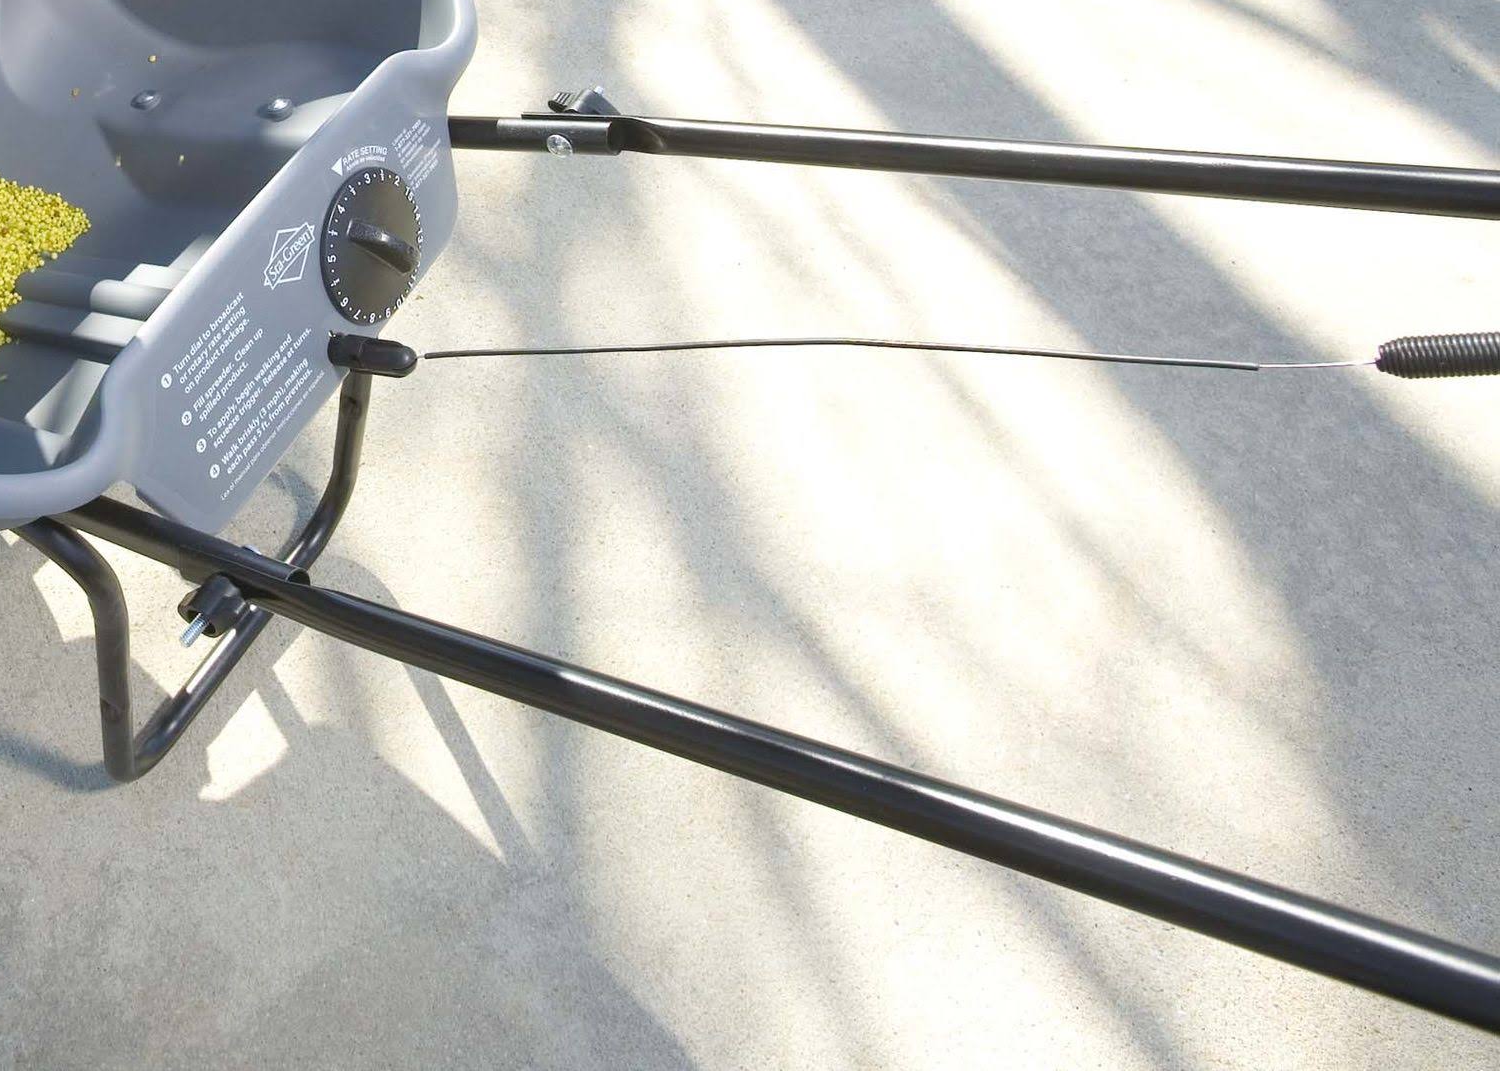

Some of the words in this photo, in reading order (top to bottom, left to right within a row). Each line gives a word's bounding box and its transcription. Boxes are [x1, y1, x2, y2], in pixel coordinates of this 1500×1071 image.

[343, 149, 360, 166] RATE
[360, 145, 387, 155] SETTING
[364, 173, 371, 184] 3
[394, 176, 400, 186] 2
[338, 205, 346, 215] 4
[328, 255, 337, 263] 5
[172, 352, 191, 374] Turn
[188, 336, 204, 356] dial
[201, 328, 212, 341] to
[208, 290, 244, 332] broadcast
[178, 372, 188, 384] or
[186, 347, 210, 376] rotary
[207, 331, 222, 350] rate
[219, 304, 246, 336] setting
[183, 379, 195, 394] on
[191, 348, 222, 384] product
[217, 314, 251, 353] package.
[370, 313, 375, 323] 8
[191, 394, 206, 412] Fill
[202, 359, 236, 400] spreader.
[233, 337, 254, 362] Clean
[252, 327, 264, 342] up
[196, 391, 223, 423] spilled
[218, 358, 250, 396] product.
[207, 425, 218, 438] To
[215, 400, 238, 429] apply,
[233, 378, 256, 406] begin
[252, 348, 281, 383] walking
[277, 333, 293, 352] and
[211, 413, 241, 450] squeeze
[237, 384, 264, 417] trigger.
[261, 354, 288, 387] Release
[285, 347, 295, 358] at
[292, 326, 312, 349] turns.
[220, 442, 239, 466] Walk
[236, 414, 262, 446] briskly
[283, 356, 309, 389] making
[225, 452, 244, 475] each
[241, 434, 259, 456] pass
[255, 427, 263, 437] 5
[260, 418, 270, 431] ft.
[267, 399, 286, 422] from
[282, 366, 314, 405] previous.
